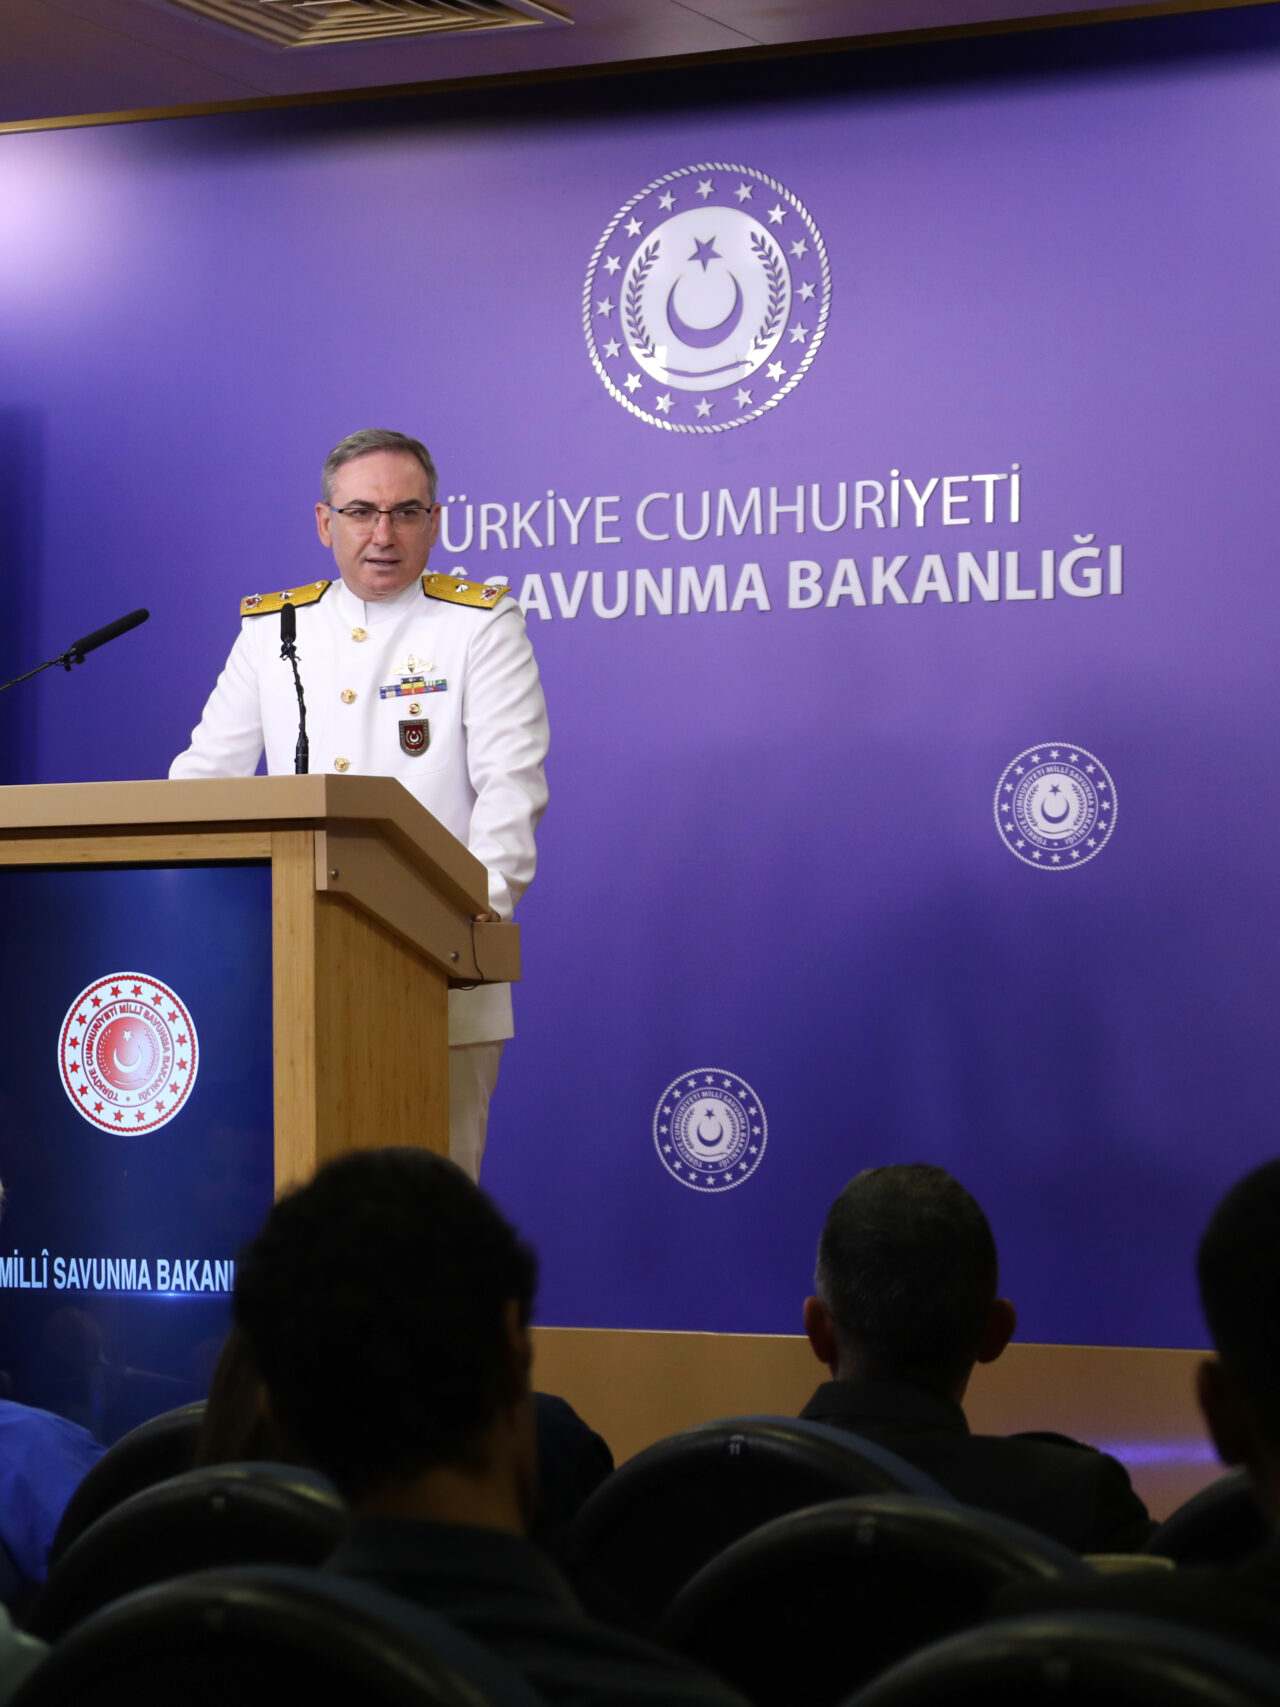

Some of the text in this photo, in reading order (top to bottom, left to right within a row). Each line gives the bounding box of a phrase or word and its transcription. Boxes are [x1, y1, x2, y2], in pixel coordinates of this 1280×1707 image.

[441, 463, 1020, 553] ÜRKİYE CUMHURİYETİ
[484, 533, 1122, 620] AVUNMA BAKANLIĞI
[53, 1257, 152, 1291] SAVUNMA
